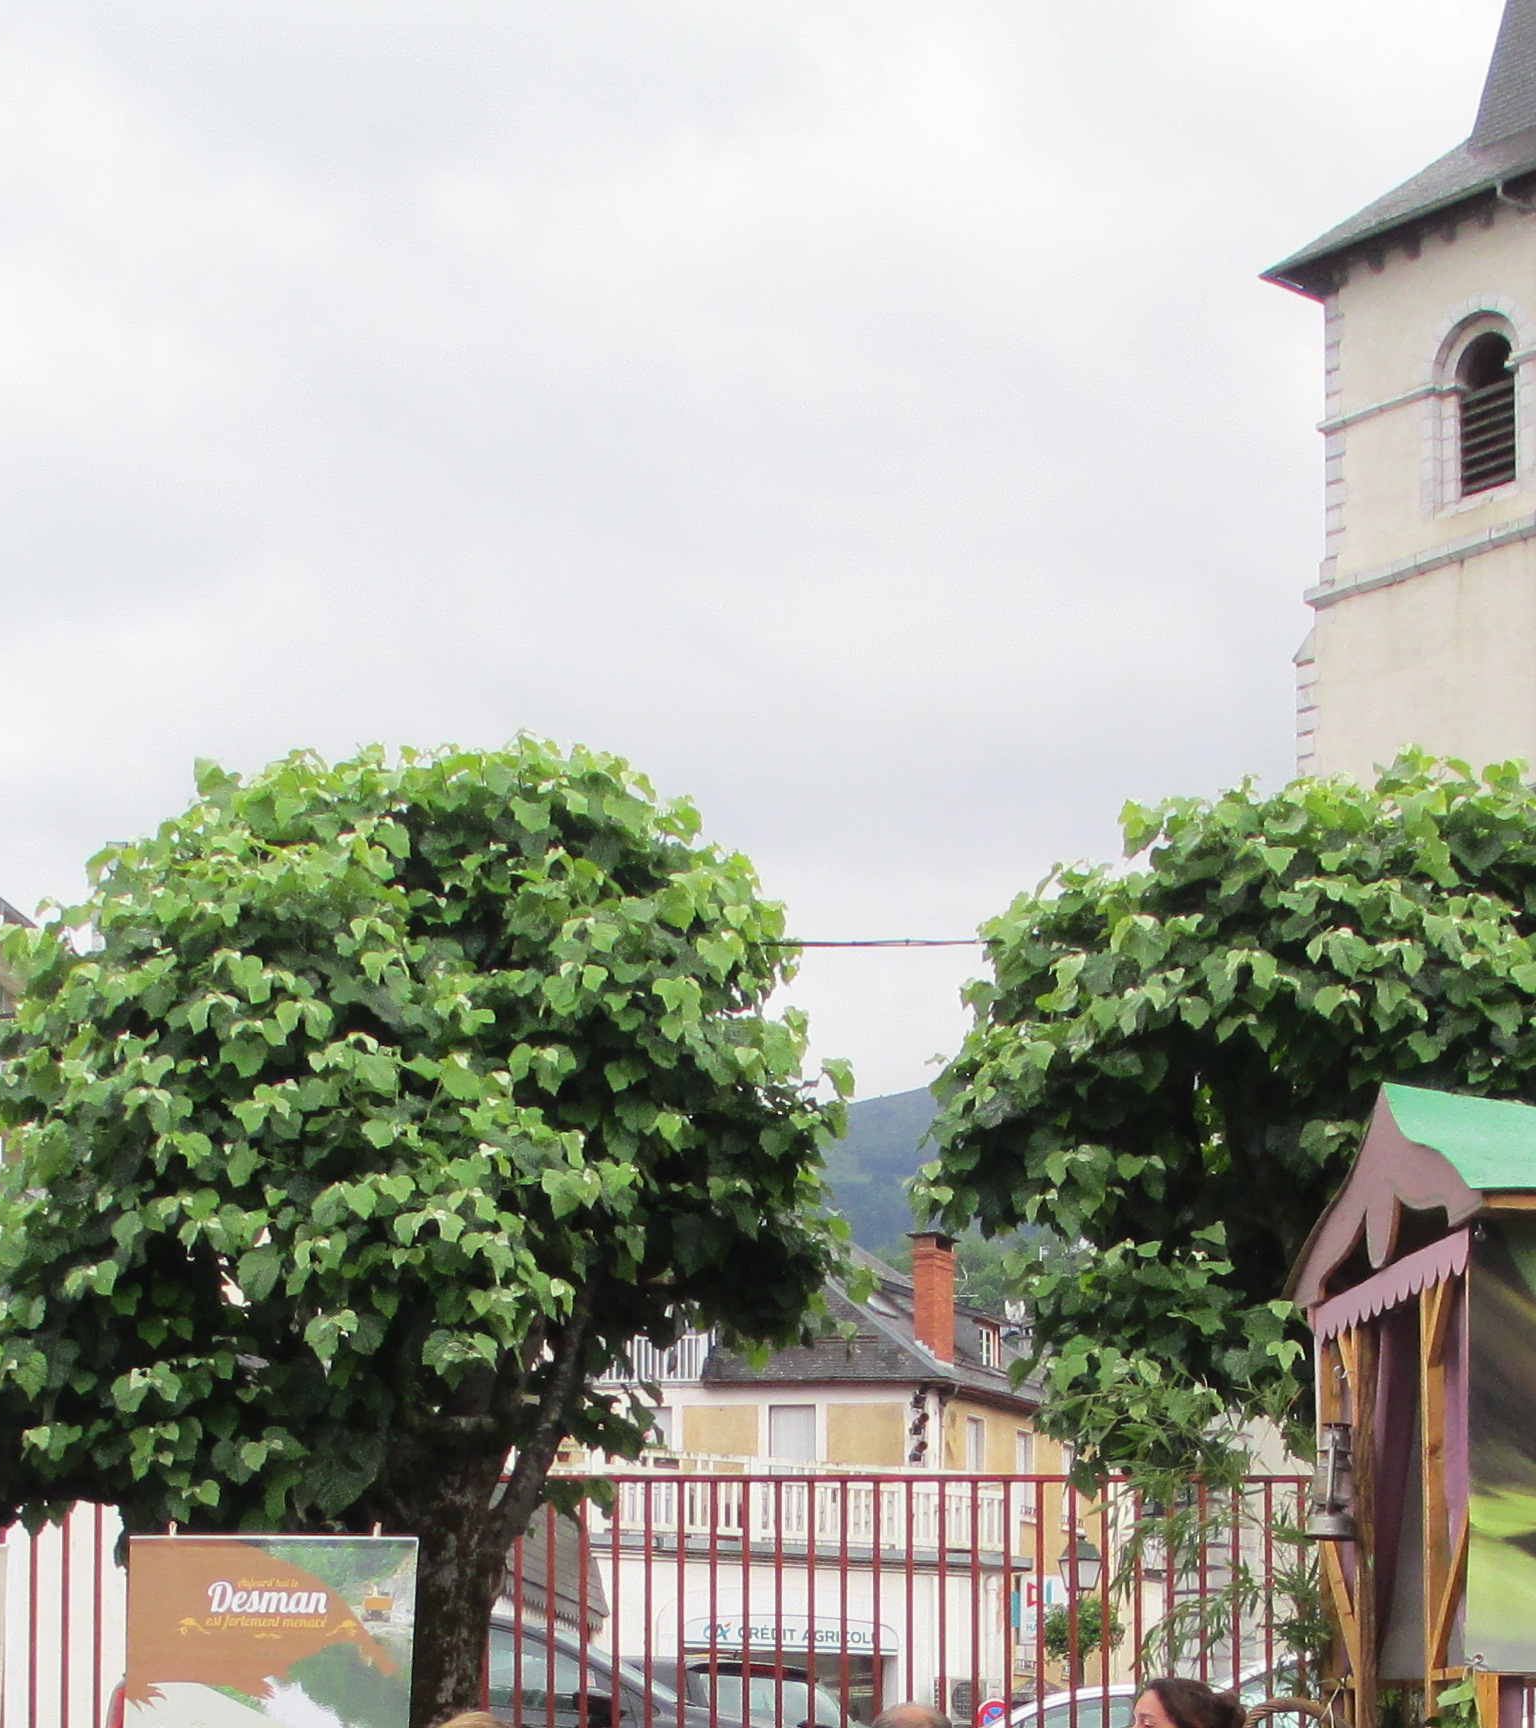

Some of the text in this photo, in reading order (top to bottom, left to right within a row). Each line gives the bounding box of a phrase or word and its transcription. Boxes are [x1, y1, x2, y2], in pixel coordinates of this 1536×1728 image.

[207, 1581, 328, 1614] Desman
[205, 1615, 329, 1630] est fortement menacé
[737, 1625, 797, 1642] CRÉDIT
[801, 1628, 876, 1644] AGRICOL
